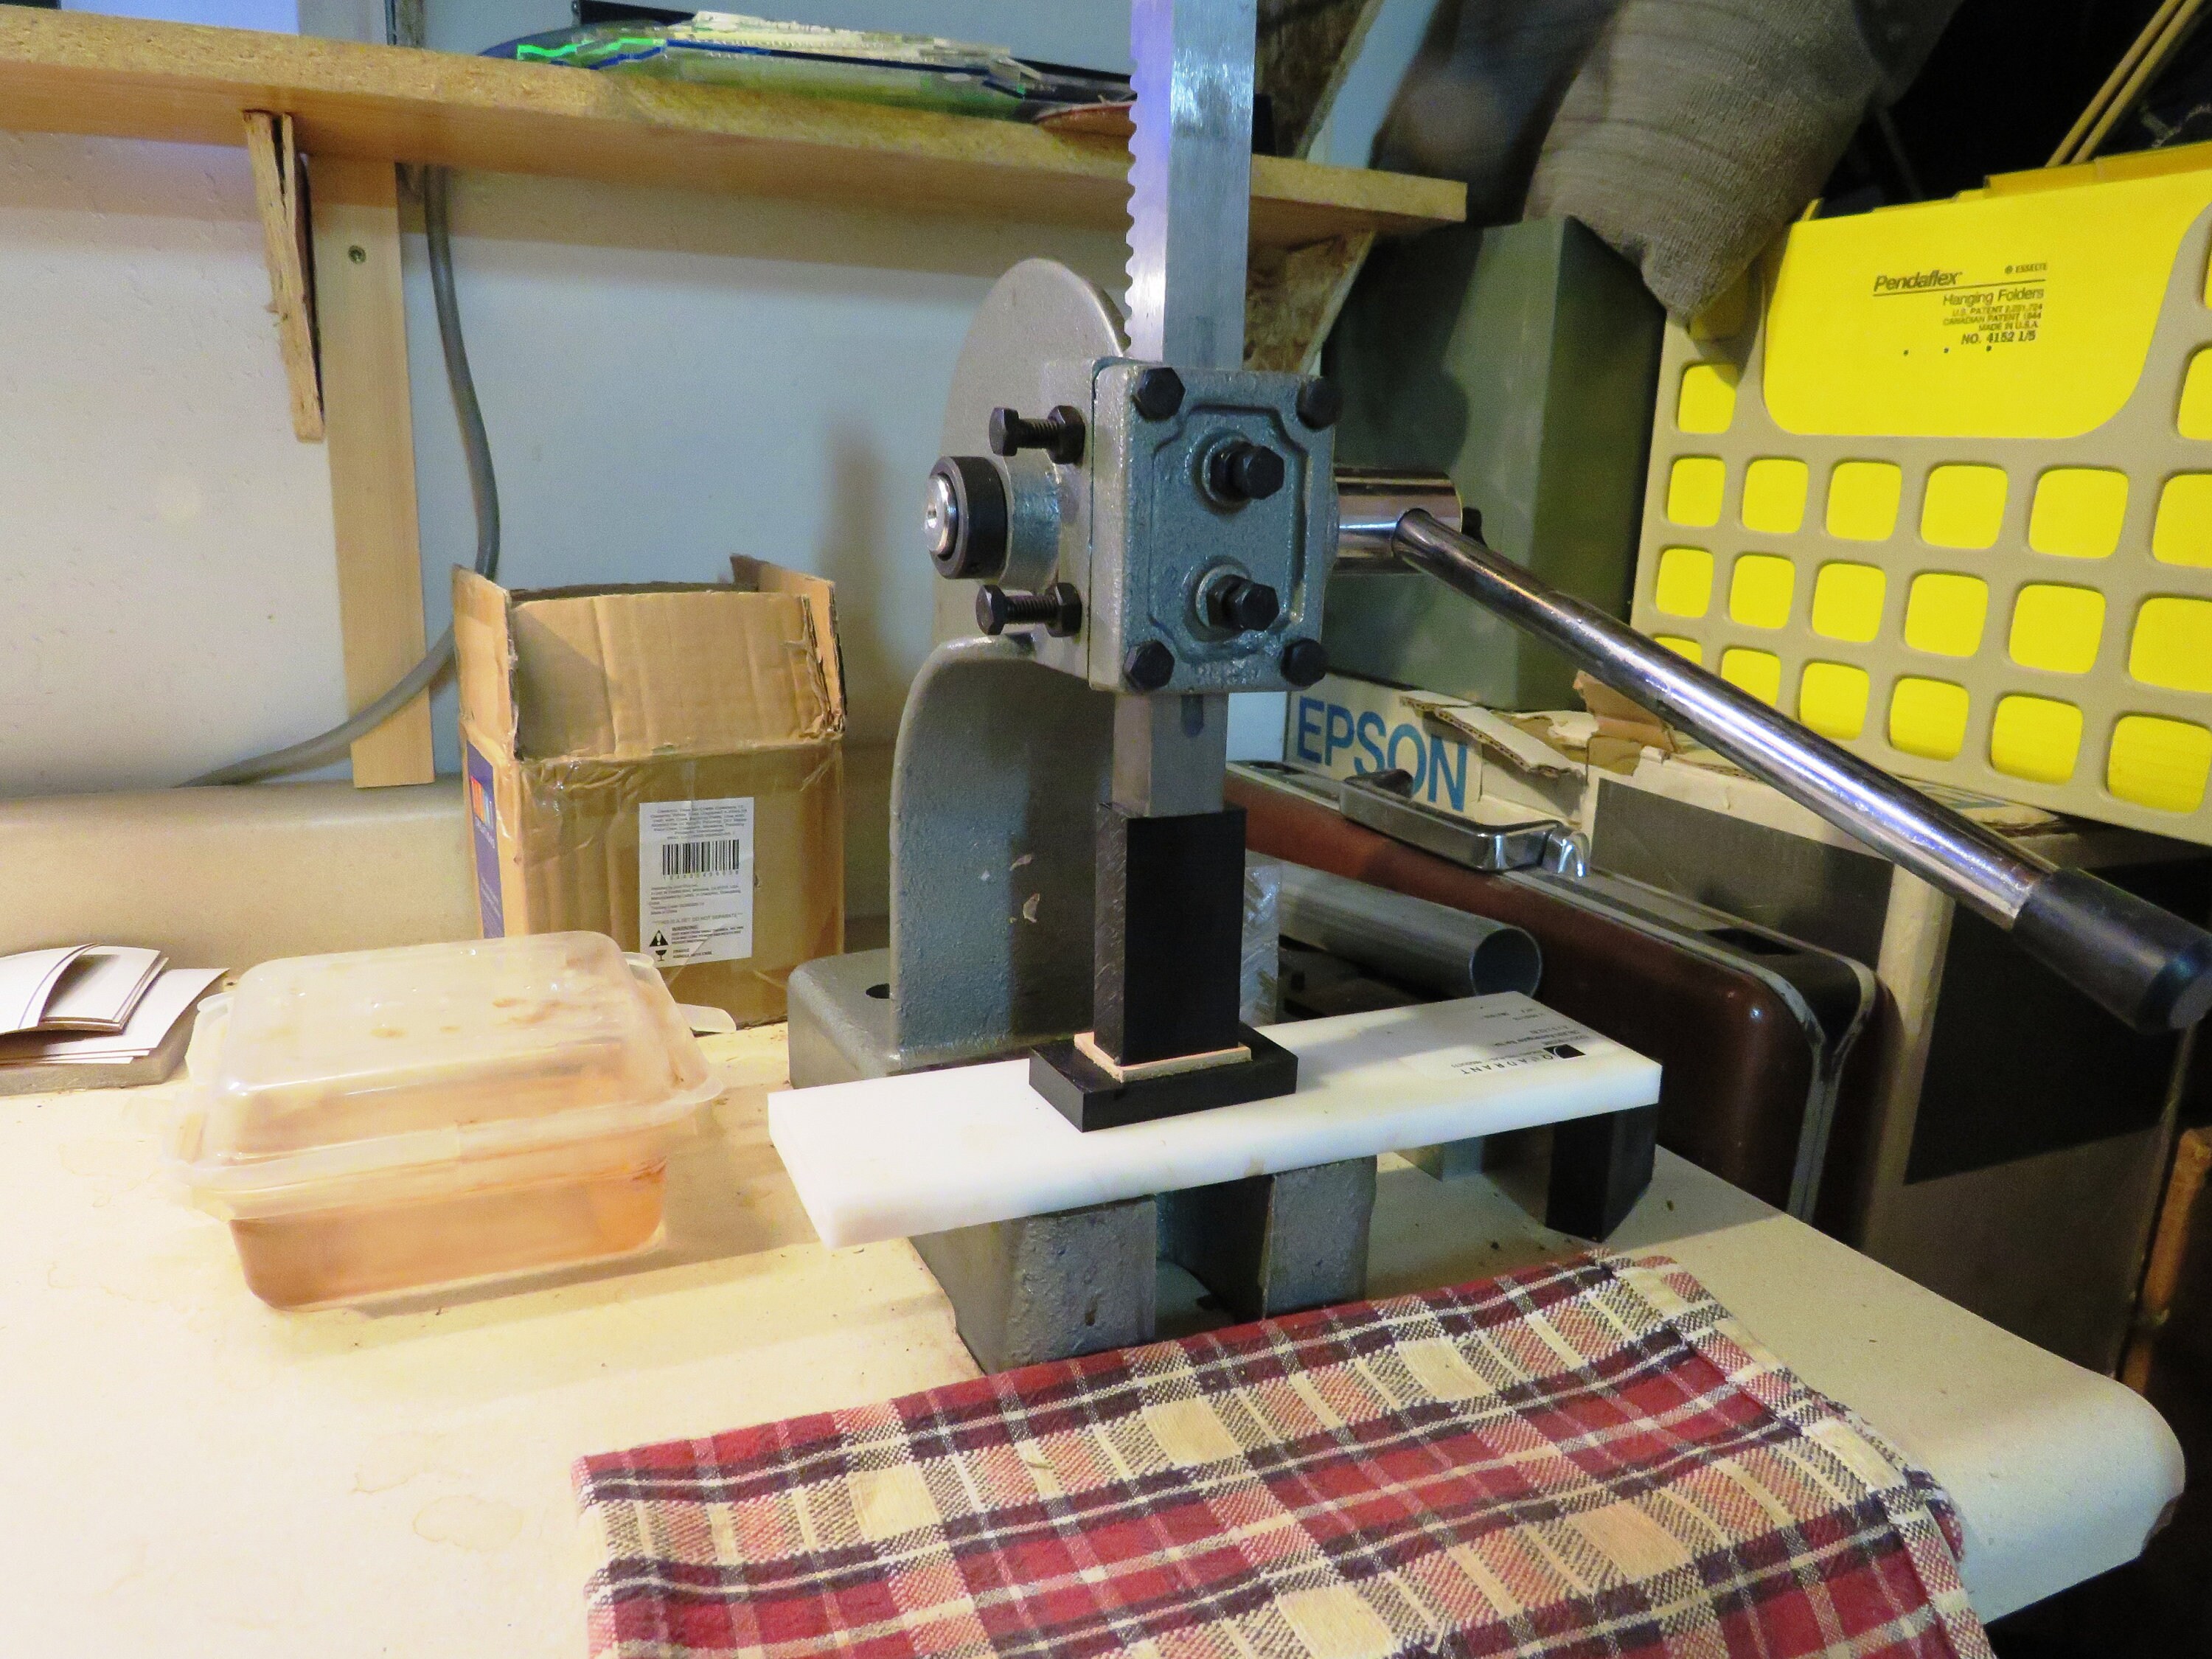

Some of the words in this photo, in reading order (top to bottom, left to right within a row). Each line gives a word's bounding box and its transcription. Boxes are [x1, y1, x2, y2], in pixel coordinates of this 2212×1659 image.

[1873, 270, 1959, 292] Pendaflex
[1943, 291, 1994, 307] Hanging
[1997, 287, 2045, 302] Folders
[1969, 305, 2003, 315] PATENT
[1987, 313, 2020, 324] PATENT
[1961, 333, 1982, 345] NO.
[1986, 331, 2014, 344] 4152
[2017, 330, 2036, 342] 1/5
[1297, 695, 1468, 813] EPSON
[1460, 1054, 1554, 1075] QUADRANT
